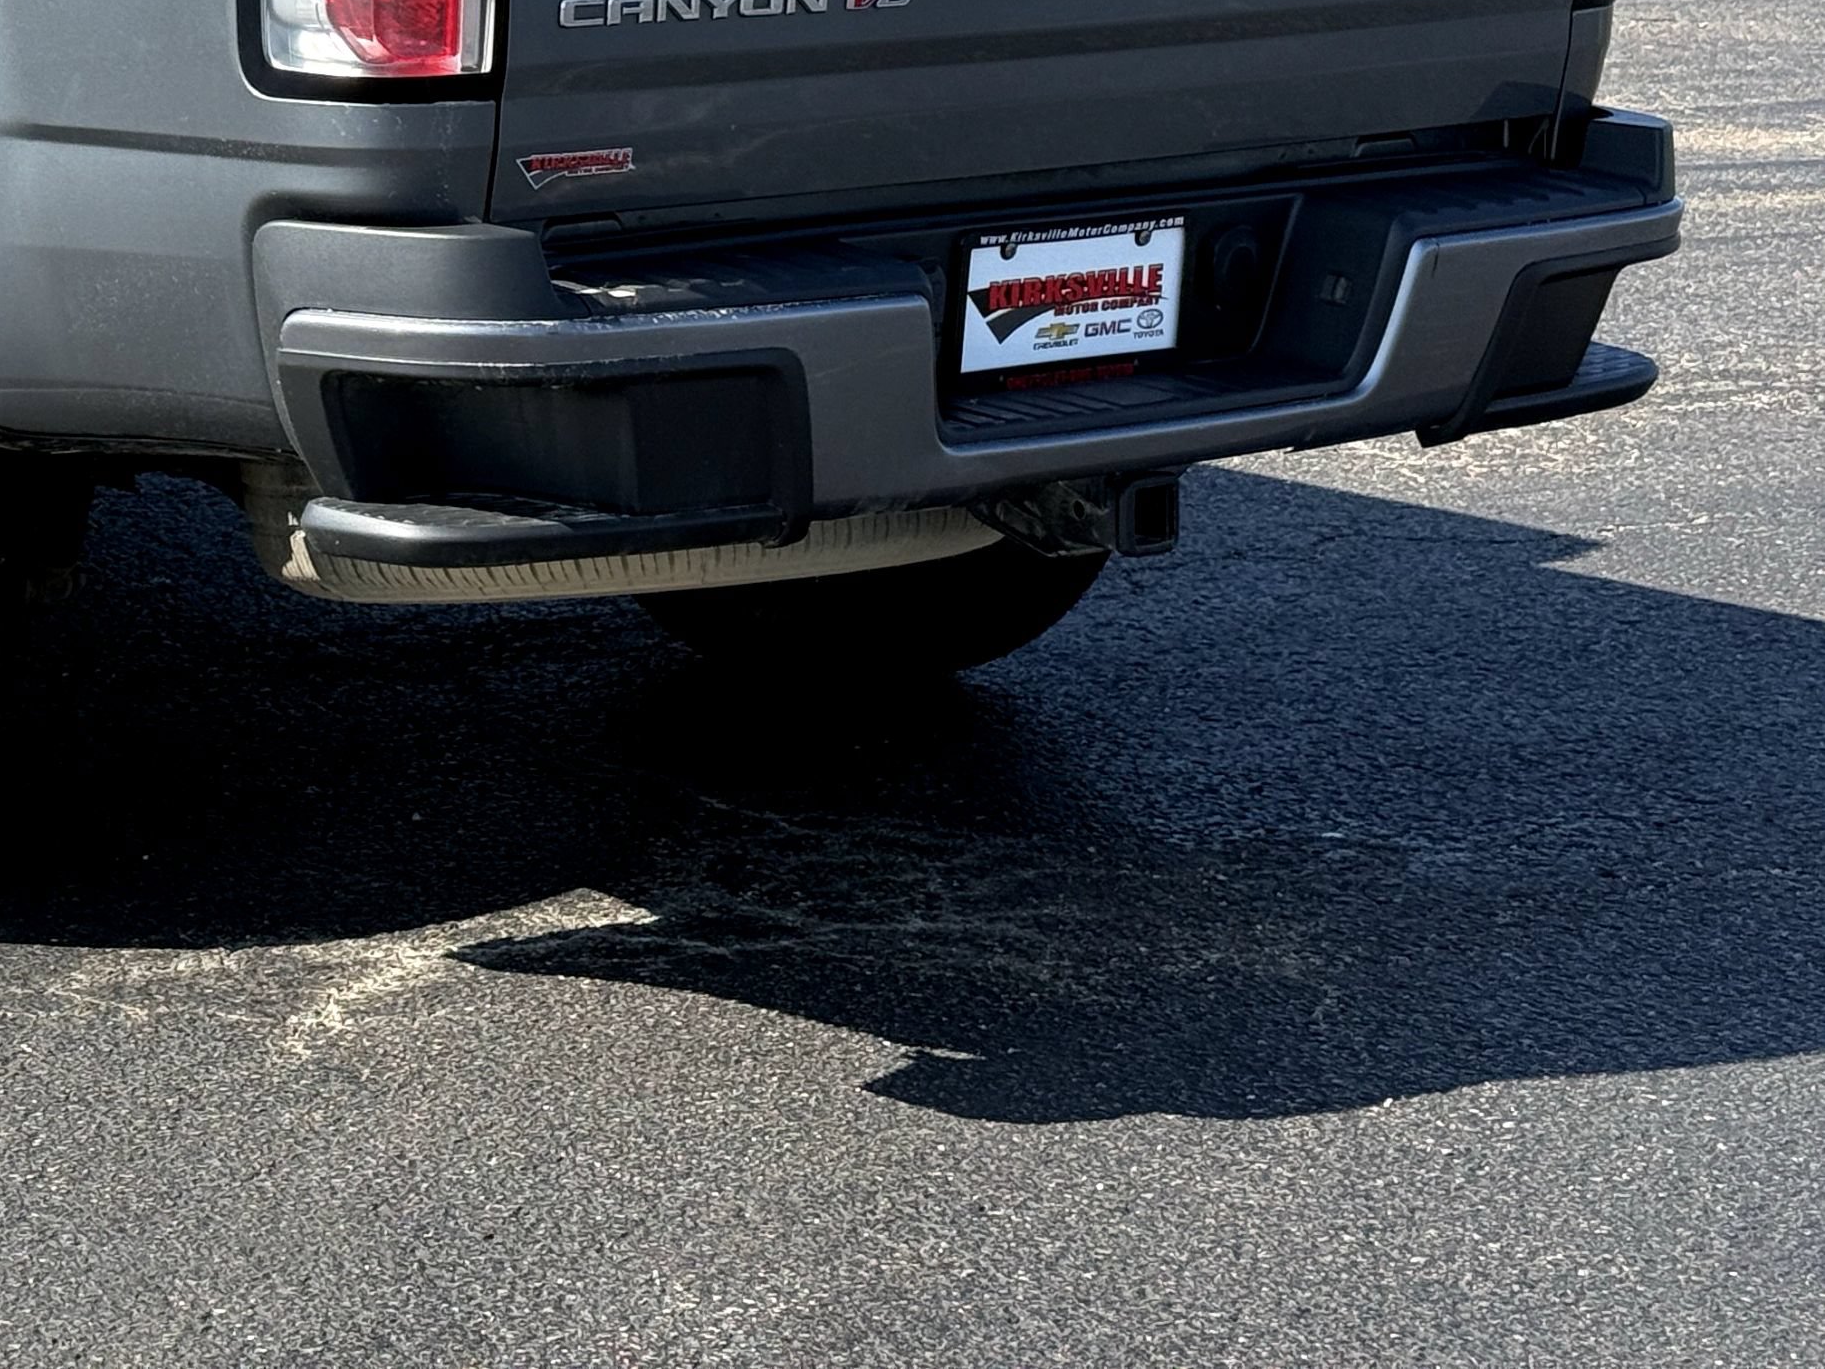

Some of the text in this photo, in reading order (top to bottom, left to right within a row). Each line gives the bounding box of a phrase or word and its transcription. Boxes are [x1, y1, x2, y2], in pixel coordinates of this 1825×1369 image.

[979, 215, 1185, 246] www.KirksvilleMotorCompany.com
[989, 263, 1164, 312] KIRKSVILLE
[1054, 296, 1161, 317] MOTOR COMPANY
[1084, 318, 1132, 338] GMC
[1133, 328, 1165, 340] TOYOTA
[1032, 338, 1079, 351] CHEVROLET
